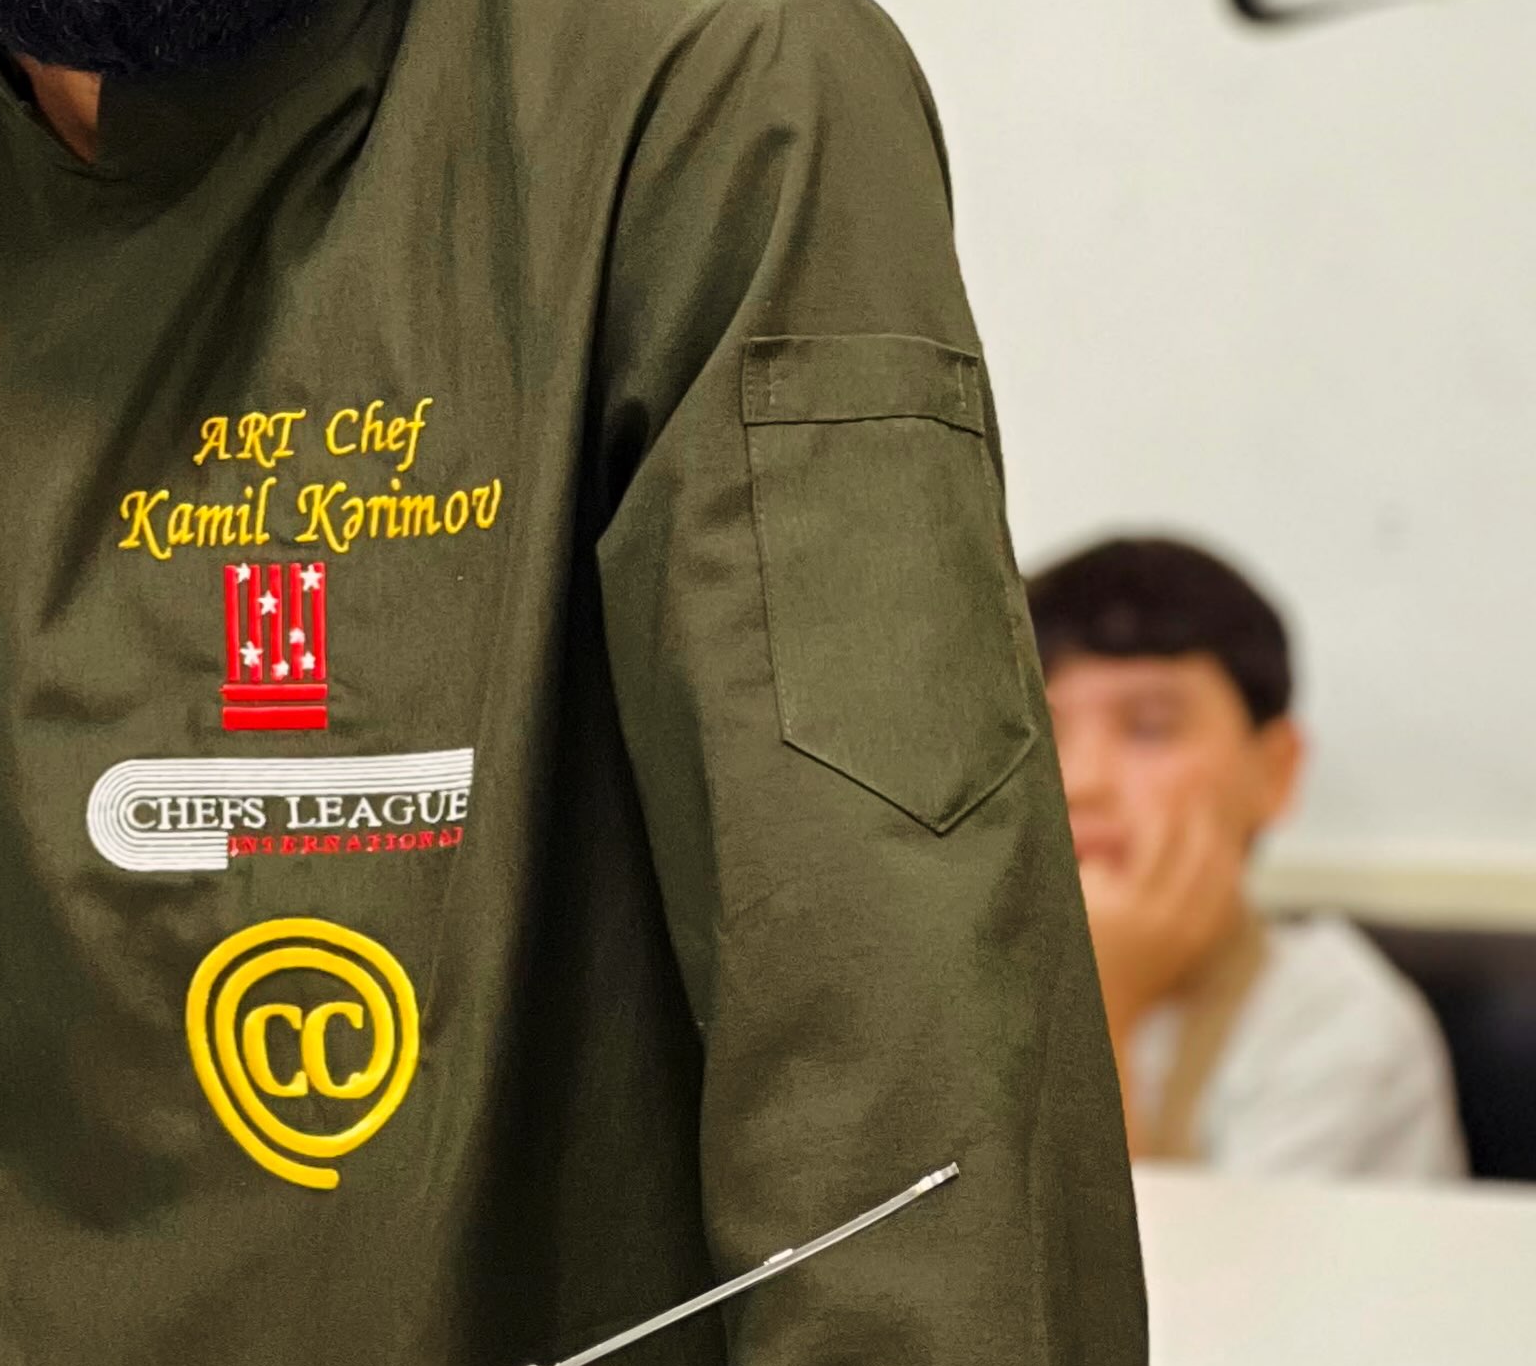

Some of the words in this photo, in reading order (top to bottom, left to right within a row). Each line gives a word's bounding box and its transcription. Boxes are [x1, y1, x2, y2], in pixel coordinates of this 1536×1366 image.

[193, 409, 306, 469] ART
[325, 397, 434, 472] Chef
[118, 476, 278, 561] Kamil
[294, 477, 502, 554] Kərimov
[125, 796, 267, 831] CHEFS
[285, 790, 470, 830] LEAGUE
[242, 1000, 366, 1100] CC
